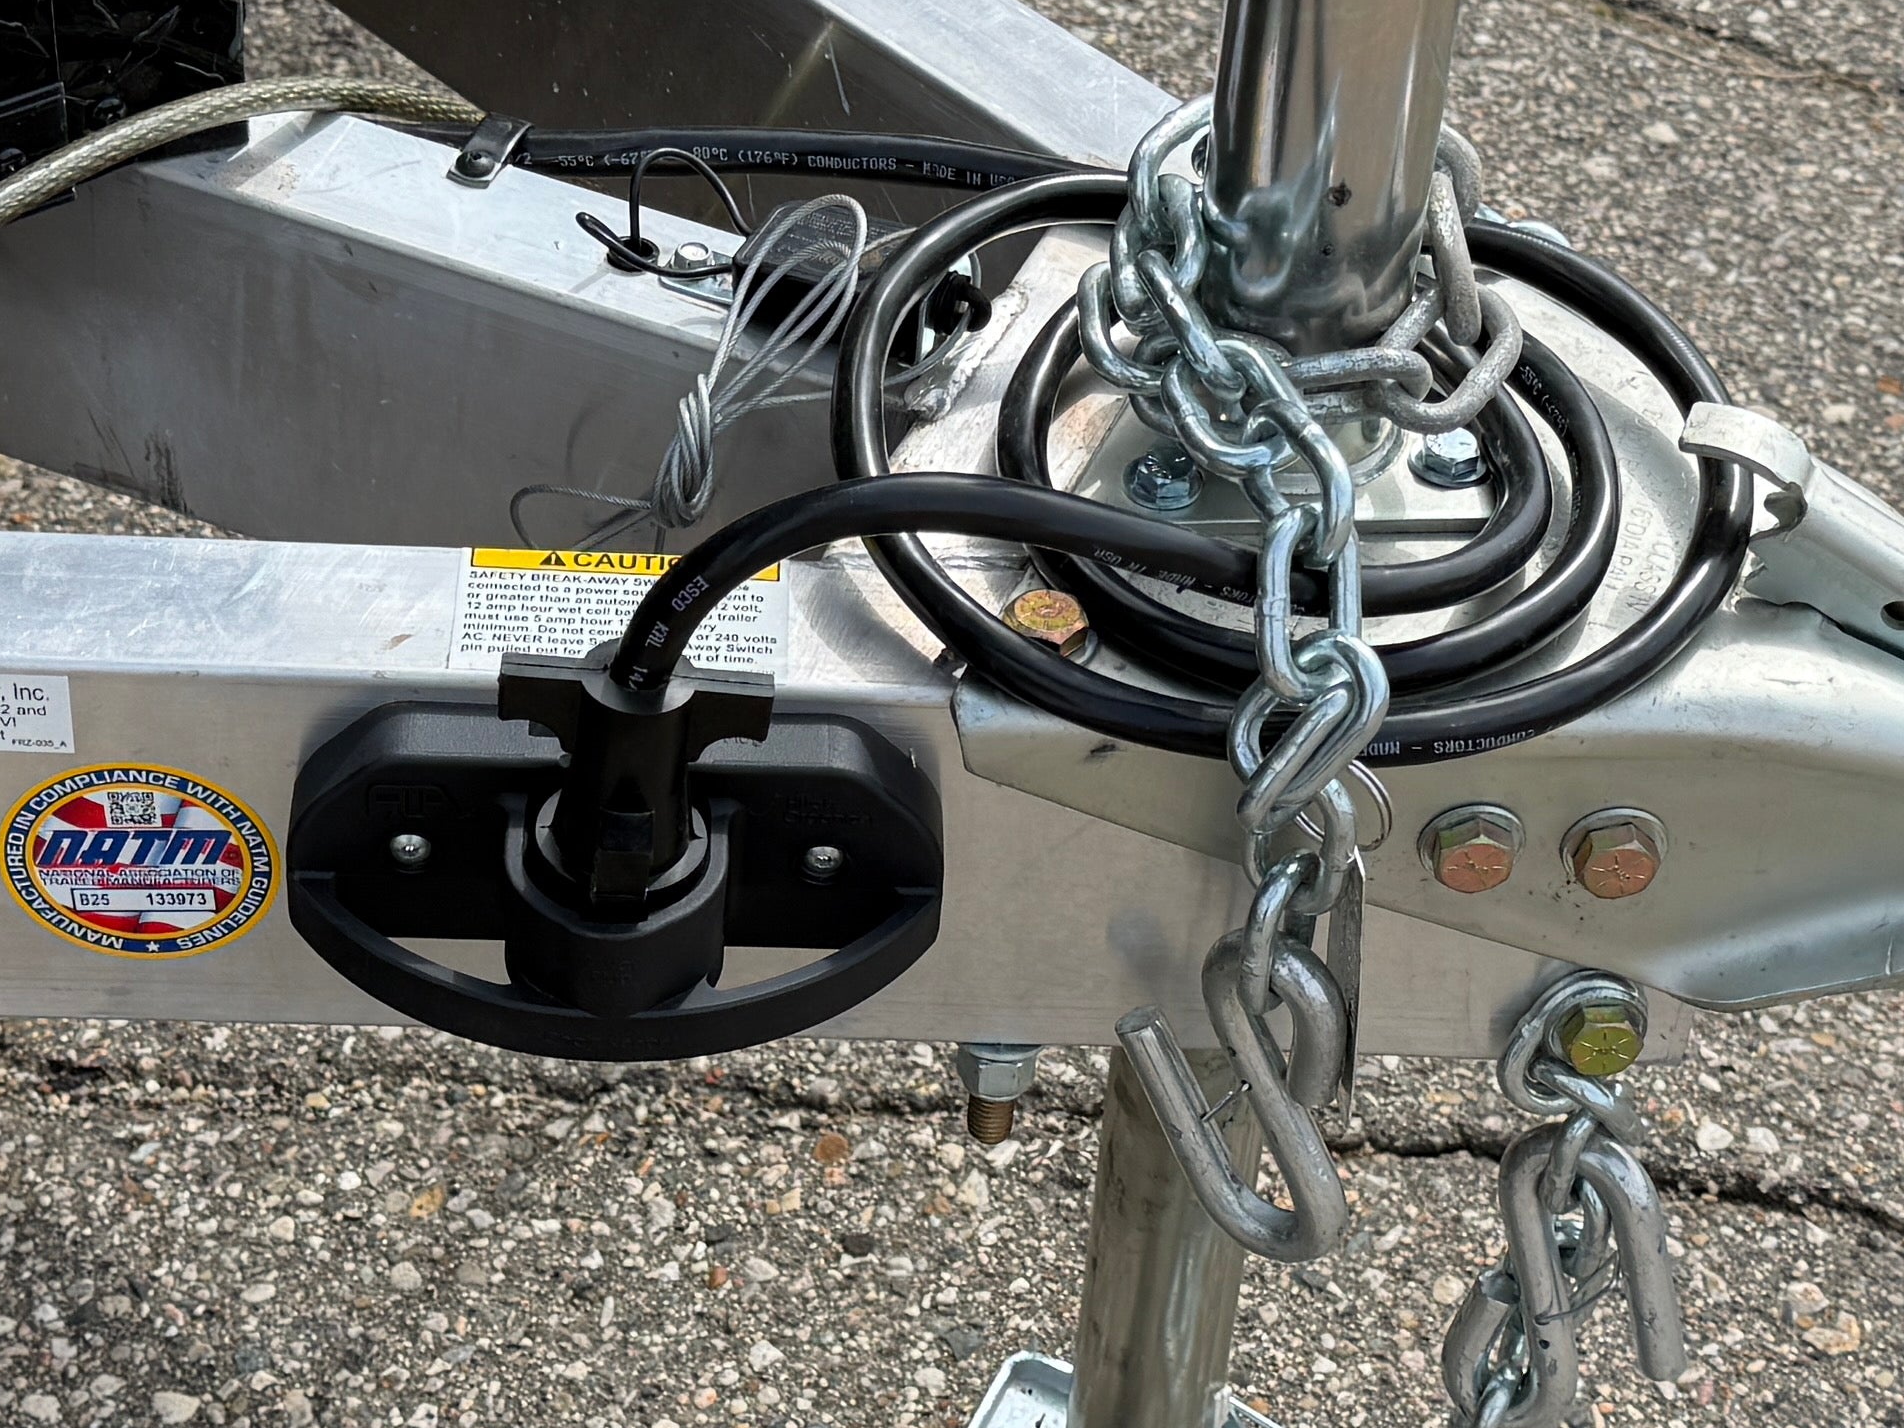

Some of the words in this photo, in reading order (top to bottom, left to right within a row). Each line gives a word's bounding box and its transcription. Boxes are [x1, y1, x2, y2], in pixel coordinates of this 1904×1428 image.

[807, 155, 896, 170] CONDUCTORS
[573, 553, 683, 571] CAUTI
[469, 571, 526, 582] SAFETY
[531, 573, 630, 586] BREAK-AWAY
[468, 582, 541, 592] connected
[546, 584, 560, 593] to
[575, 587, 618, 597] power
[751, 594, 764, 602] to
[486, 593, 535, 603] greater
[540, 595, 571, 604] than
[575, 597, 591, 605] an
[464, 612, 499, 621] must
[505, 614, 529, 622] use
[534, 615, 542, 623] 5
[546, 616, 576, 625] amp
[581, 616, 612, 626] hour
[467, 602, 480, 610] 12
[486, 604, 516, 613] amp
[521, 603, 553, 613] hour
[558, 606, 581, 615] wet
[718, 613, 758, 622] trailer
[463, 623, 533, 633] minimum.
[538, 625, 557, 634] Do
[562, 627, 584, 636] not
[715, 634, 738, 642] 240
[744, 635, 777, 644] volts
[461, 644, 482, 653] pin
[487, 645, 531, 654] pulled
[563, 648, 583, 656] for
[706, 654, 719, 662] of
[724, 655, 758, 664] time.
[492, 634, 543, 644] NEVER
[548, 636, 584, 646] leave
[726, 644, 773, 654] Switch
[14, 683, 50, 702] Inc.
[17, 705, 47, 716] and
[0, 716, 17, 728] VI
[29, 770, 185, 811] COMPLIANCE
[185, 782, 242, 820] WITH
[12, 816, 32, 836] IN
[238, 819, 270, 873] NATM
[39, 869, 115, 878] NATIONAL
[6, 832, 124, 950] MANUFACTURED
[80, 893, 110, 906] B25
[147, 893, 207, 906] 133973
[176, 877, 271, 951] GUIDELINES
